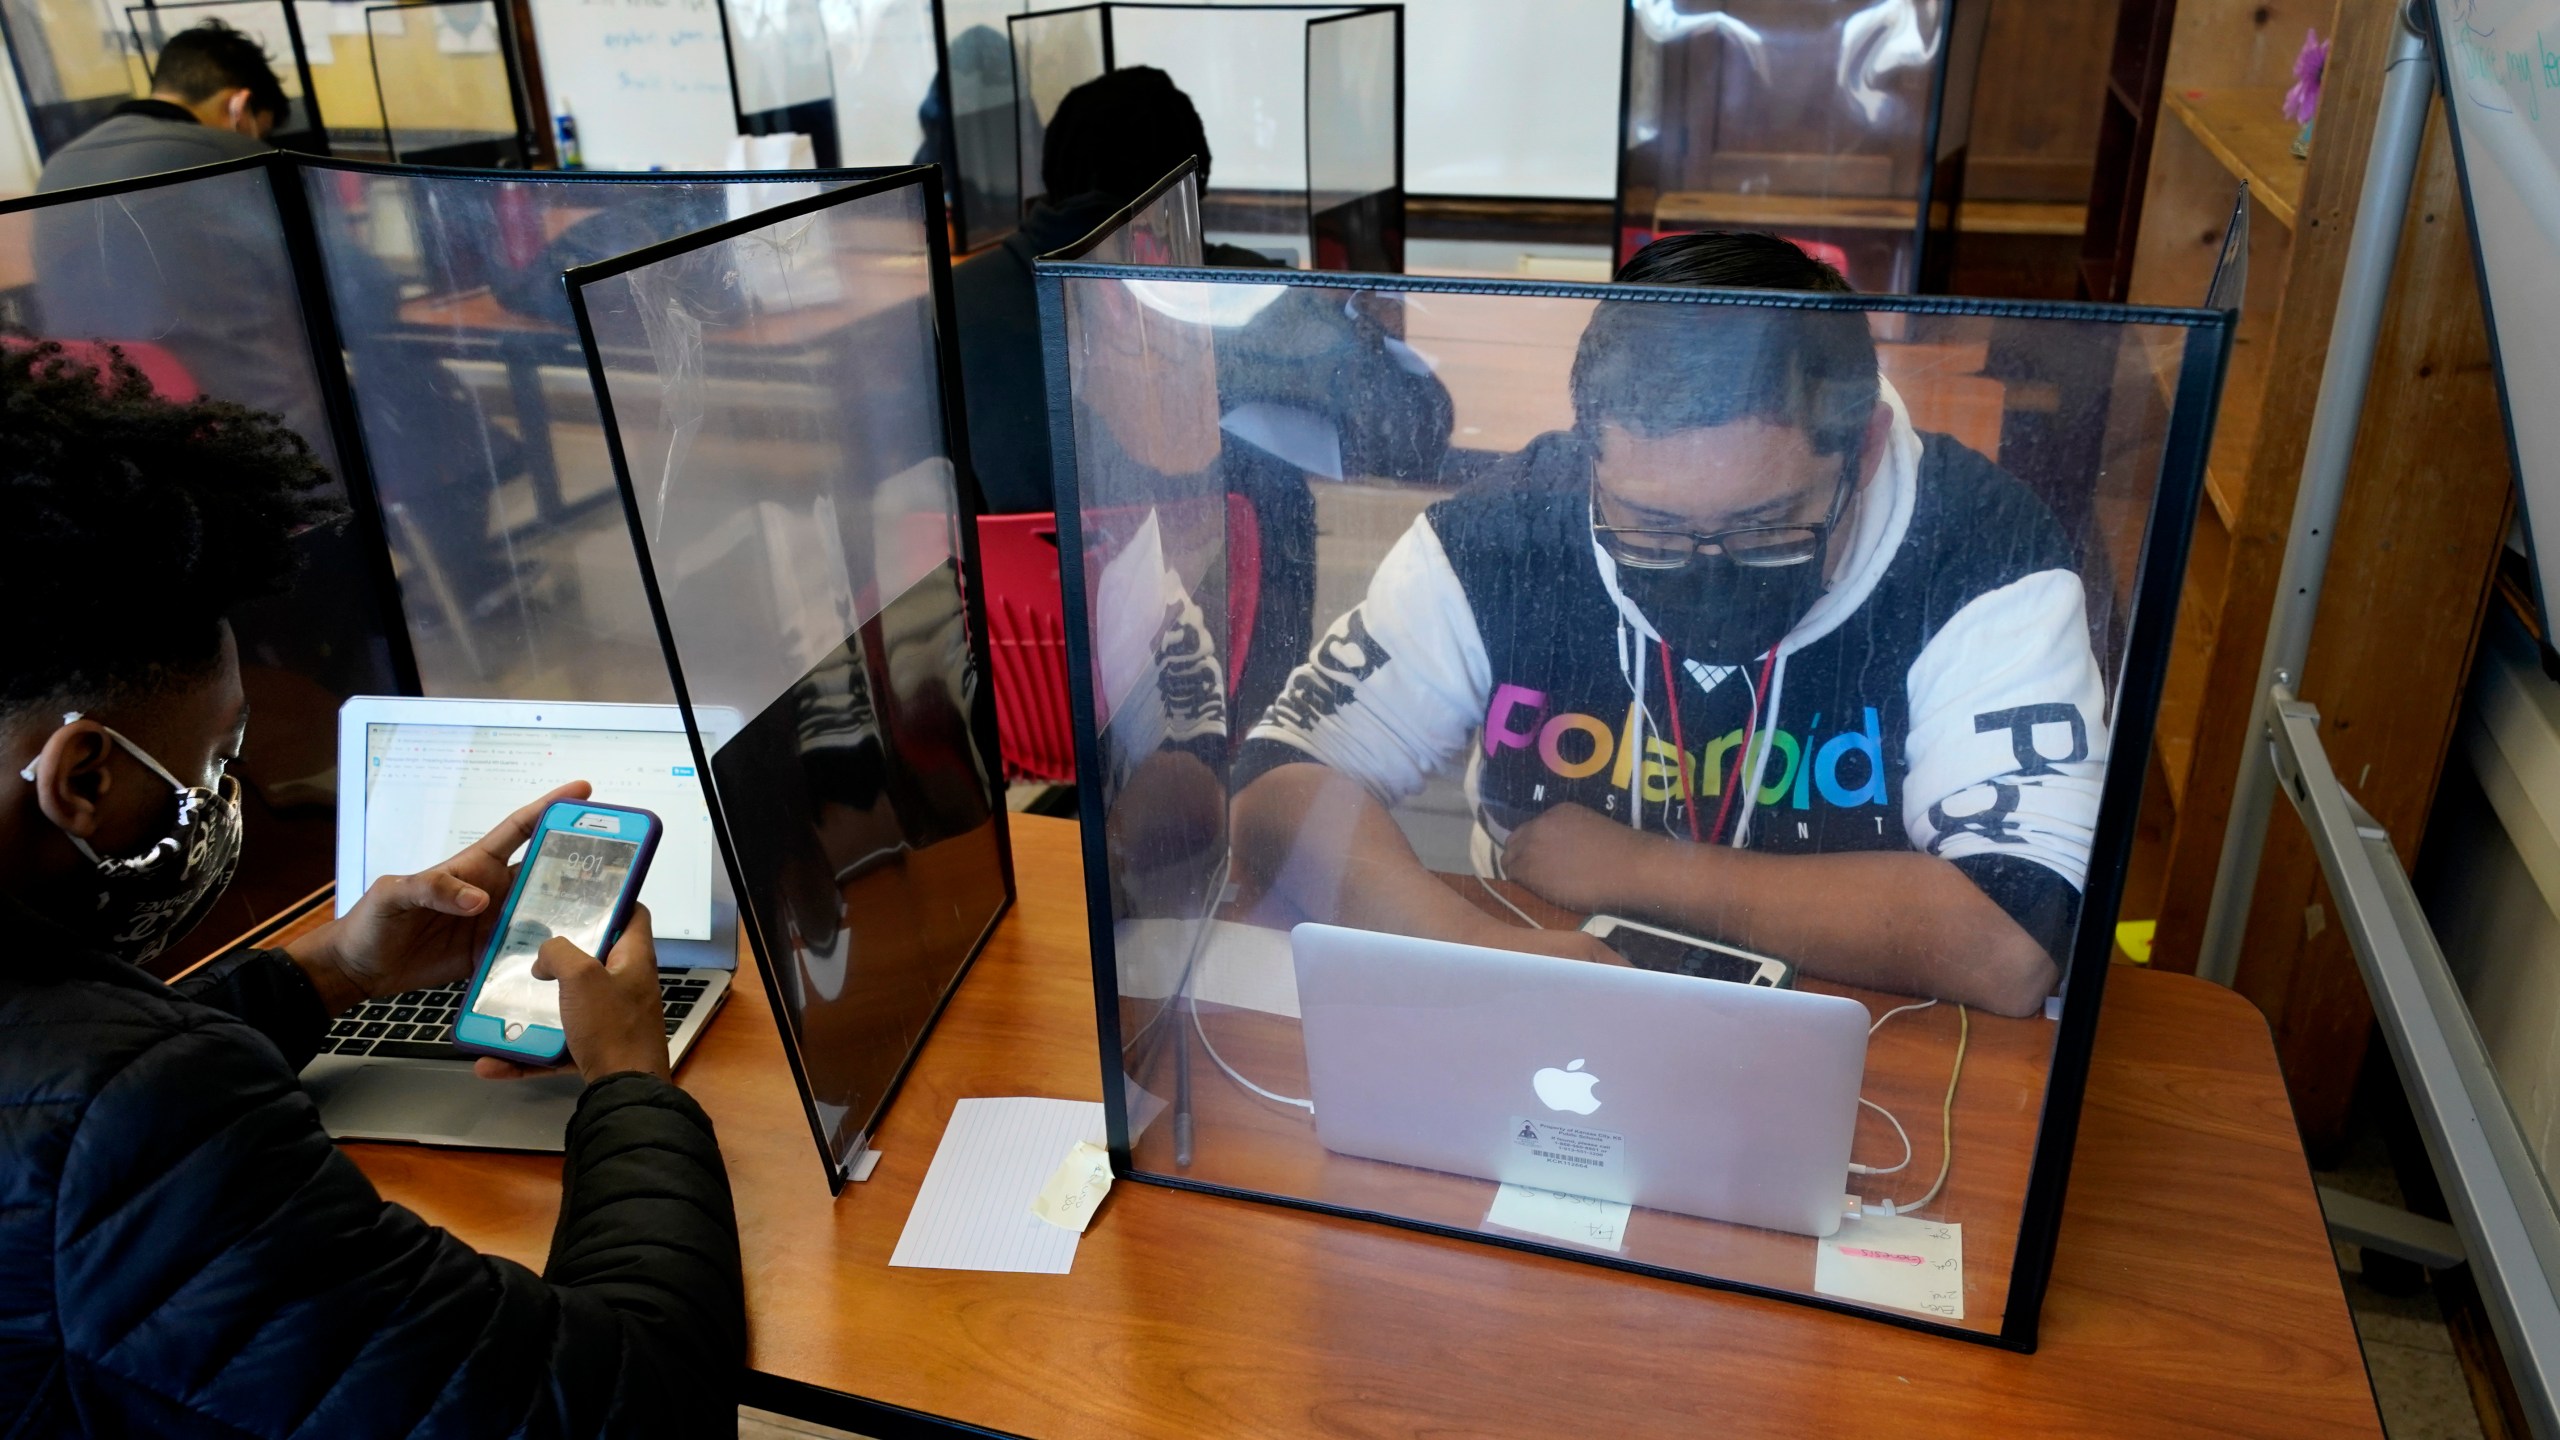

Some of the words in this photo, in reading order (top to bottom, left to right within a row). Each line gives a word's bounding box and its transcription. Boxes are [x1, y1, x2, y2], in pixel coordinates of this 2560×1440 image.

[1484, 682, 1888, 810] Polaroid
[568, 852, 604, 873] 9:01
[1575, 1129, 1597, 1137] Kansas
[1860, 1248, 1922, 1267] Genesis
[1920, 1301, 1956, 1315] Even
